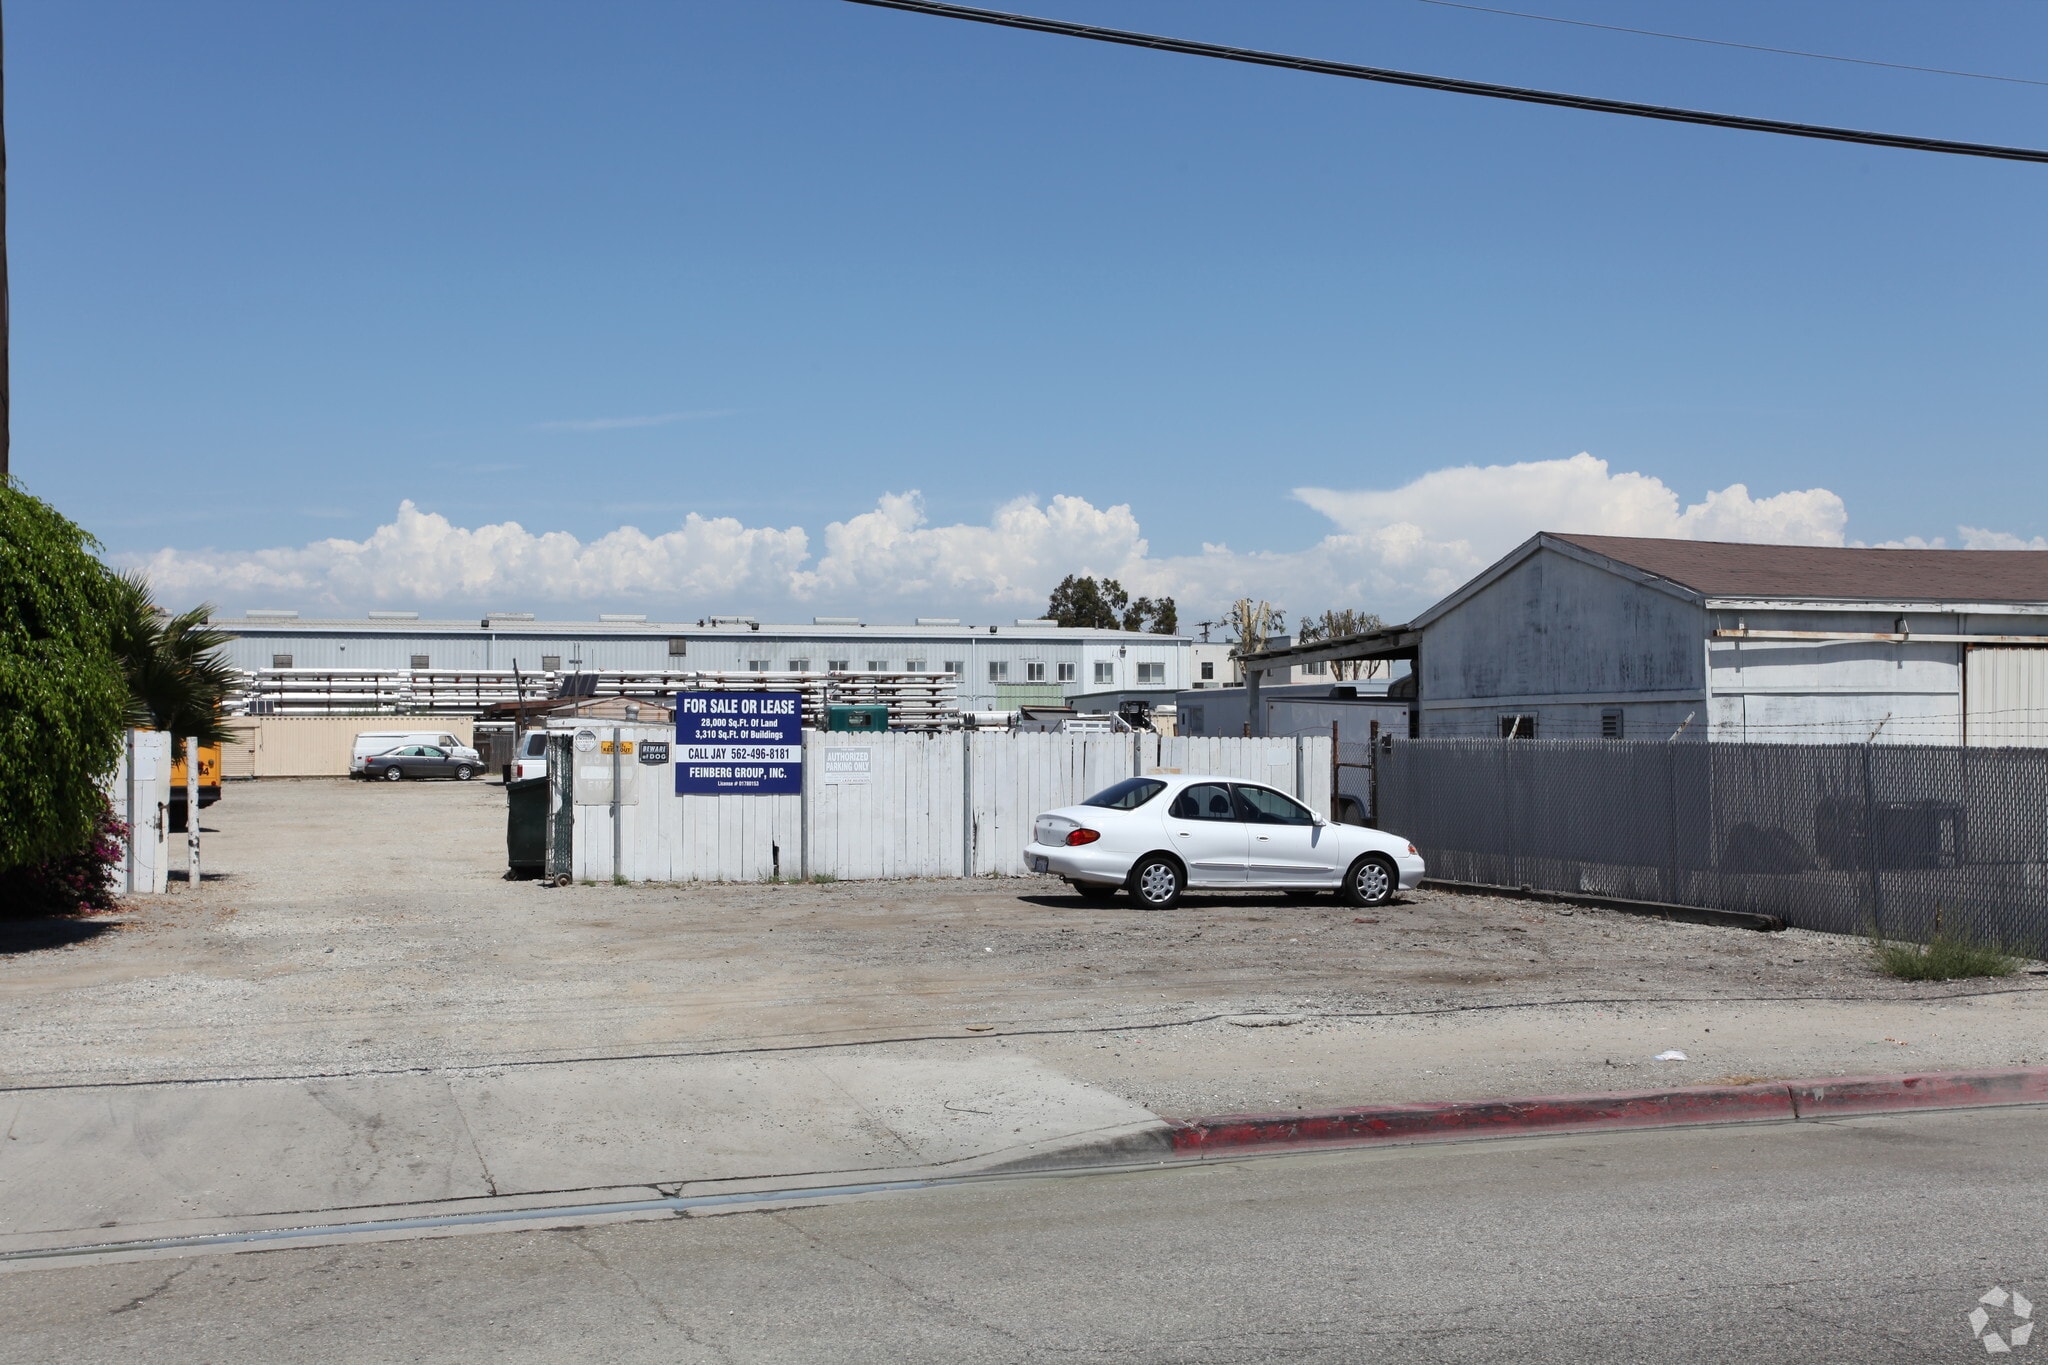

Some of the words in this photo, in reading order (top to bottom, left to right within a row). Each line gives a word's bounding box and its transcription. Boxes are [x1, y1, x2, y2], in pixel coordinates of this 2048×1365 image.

[683, 698, 707, 714] FOR
[710, 699, 738, 714] SALE
[741, 699, 757, 714] OR
[761, 699, 795, 715] LEASE
[701, 718, 726, 728] 28,000
[728, 718, 749, 728] Sq.Ft.
[751, 718, 759, 727] Of
[760, 718, 778, 727] Land
[695, 730, 716, 739] 3,310
[718, 730, 739, 740] Sq.Ft.
[740, 730, 749, 739] Of
[750, 730, 784, 740] Buildings
[642, 745, 666, 753] BEWARE
[688, 748, 709, 760] CALL
[711, 748, 726, 760] JAY
[731, 748, 790, 760] 562-496-8181
[827, 752, 869, 762] AUTHORIZED
[825, 761, 853, 772] PARKING
[853, 761, 870, 772] ONLY
[689, 767, 732, 779] FEINBERG
[734, 767, 767, 780] GROUP,
[769, 767, 787, 779] INC.
